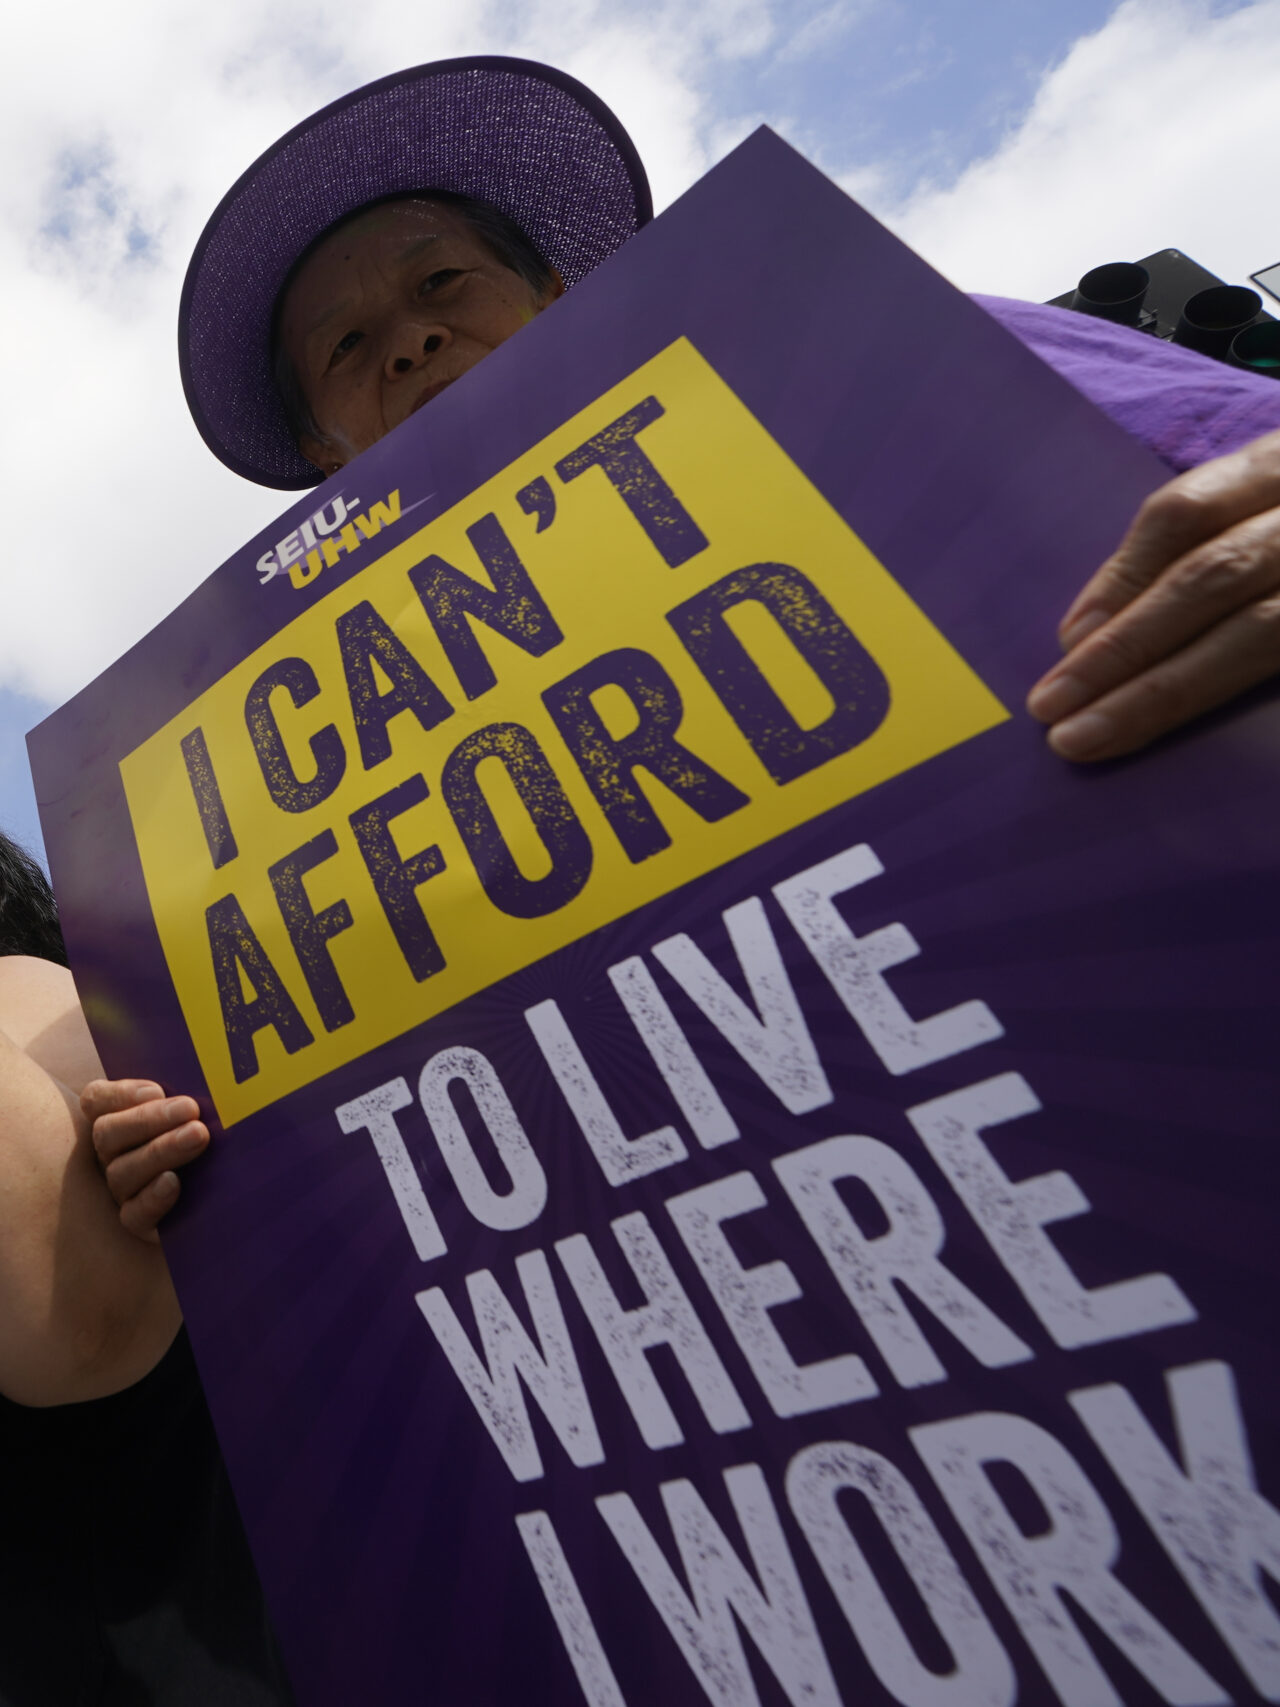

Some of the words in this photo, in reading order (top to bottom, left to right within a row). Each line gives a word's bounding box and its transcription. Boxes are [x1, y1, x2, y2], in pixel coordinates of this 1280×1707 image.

[288, 488, 402, 590] UHW
[179, 725, 240, 870] I
[204, 561, 892, 1085] AFFORD
[334, 1045, 549, 1262] TO
[523, 841, 1006, 1189] LIVE
[413, 1070, 1199, 1484] WHERE
[514, 1509, 627, 1707] I
[593, 1358, 1280, 1707] WORK
